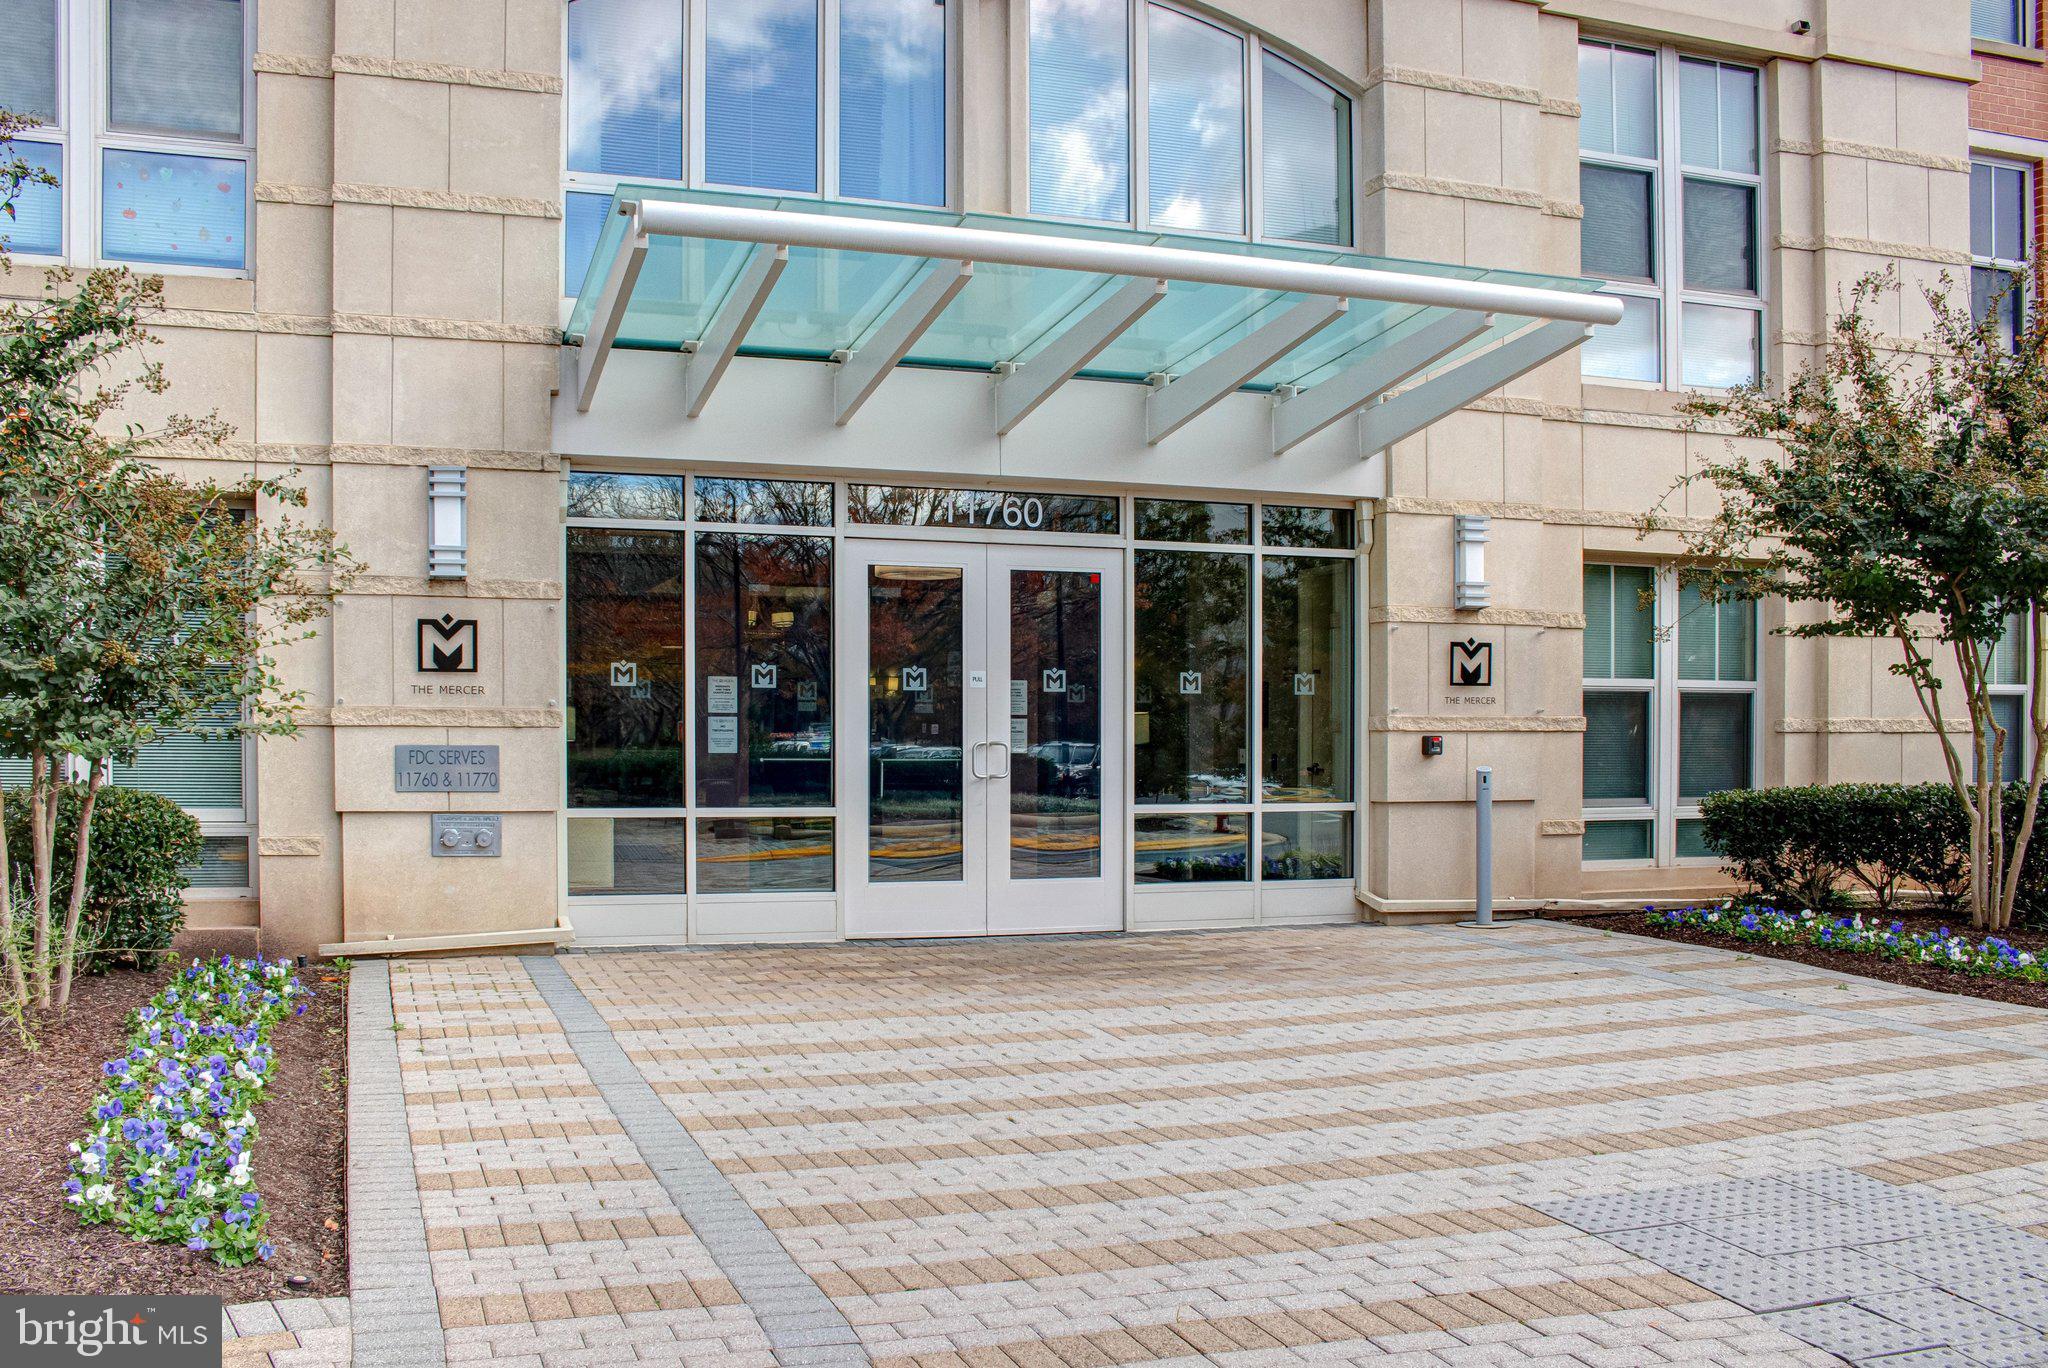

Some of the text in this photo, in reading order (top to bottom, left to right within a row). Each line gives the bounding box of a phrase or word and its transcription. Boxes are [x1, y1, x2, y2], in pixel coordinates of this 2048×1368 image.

[944, 491, 1043, 528] 11760
[411, 684, 486, 695] THE MERCER
[1445, 696, 1496, 705] THE MERCER
[408, 749, 486, 765] FDC SERVES
[398, 772, 498, 787] 11760 & 11770
